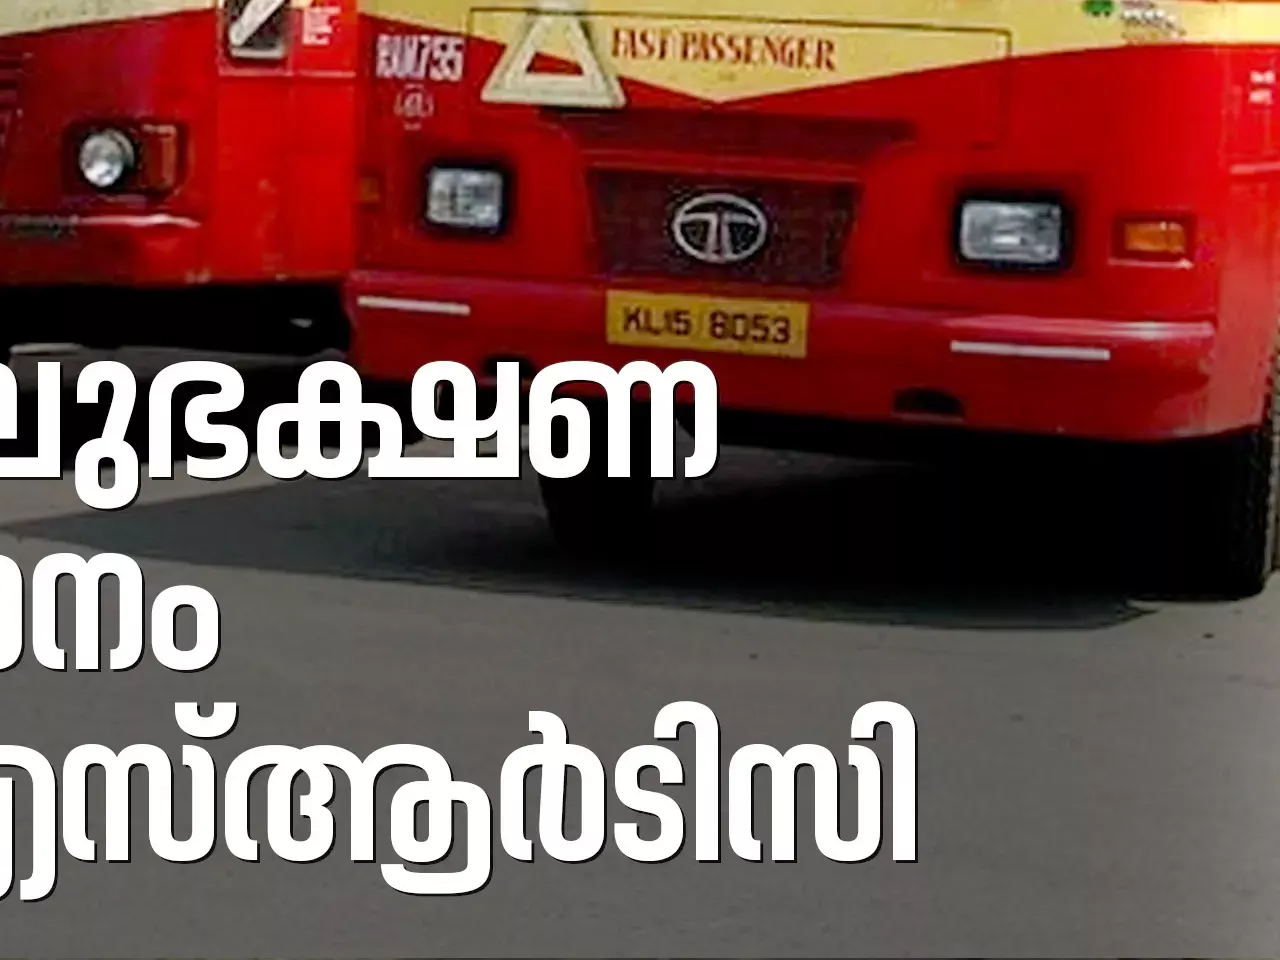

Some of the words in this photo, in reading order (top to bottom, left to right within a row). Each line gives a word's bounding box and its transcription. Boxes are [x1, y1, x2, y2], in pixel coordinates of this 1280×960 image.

[611, 26, 673, 61] FAST
[680, 29, 836, 72] PASSENGER
[622, 304, 693, 337] KL15
[708, 309, 791, 344] 8053
